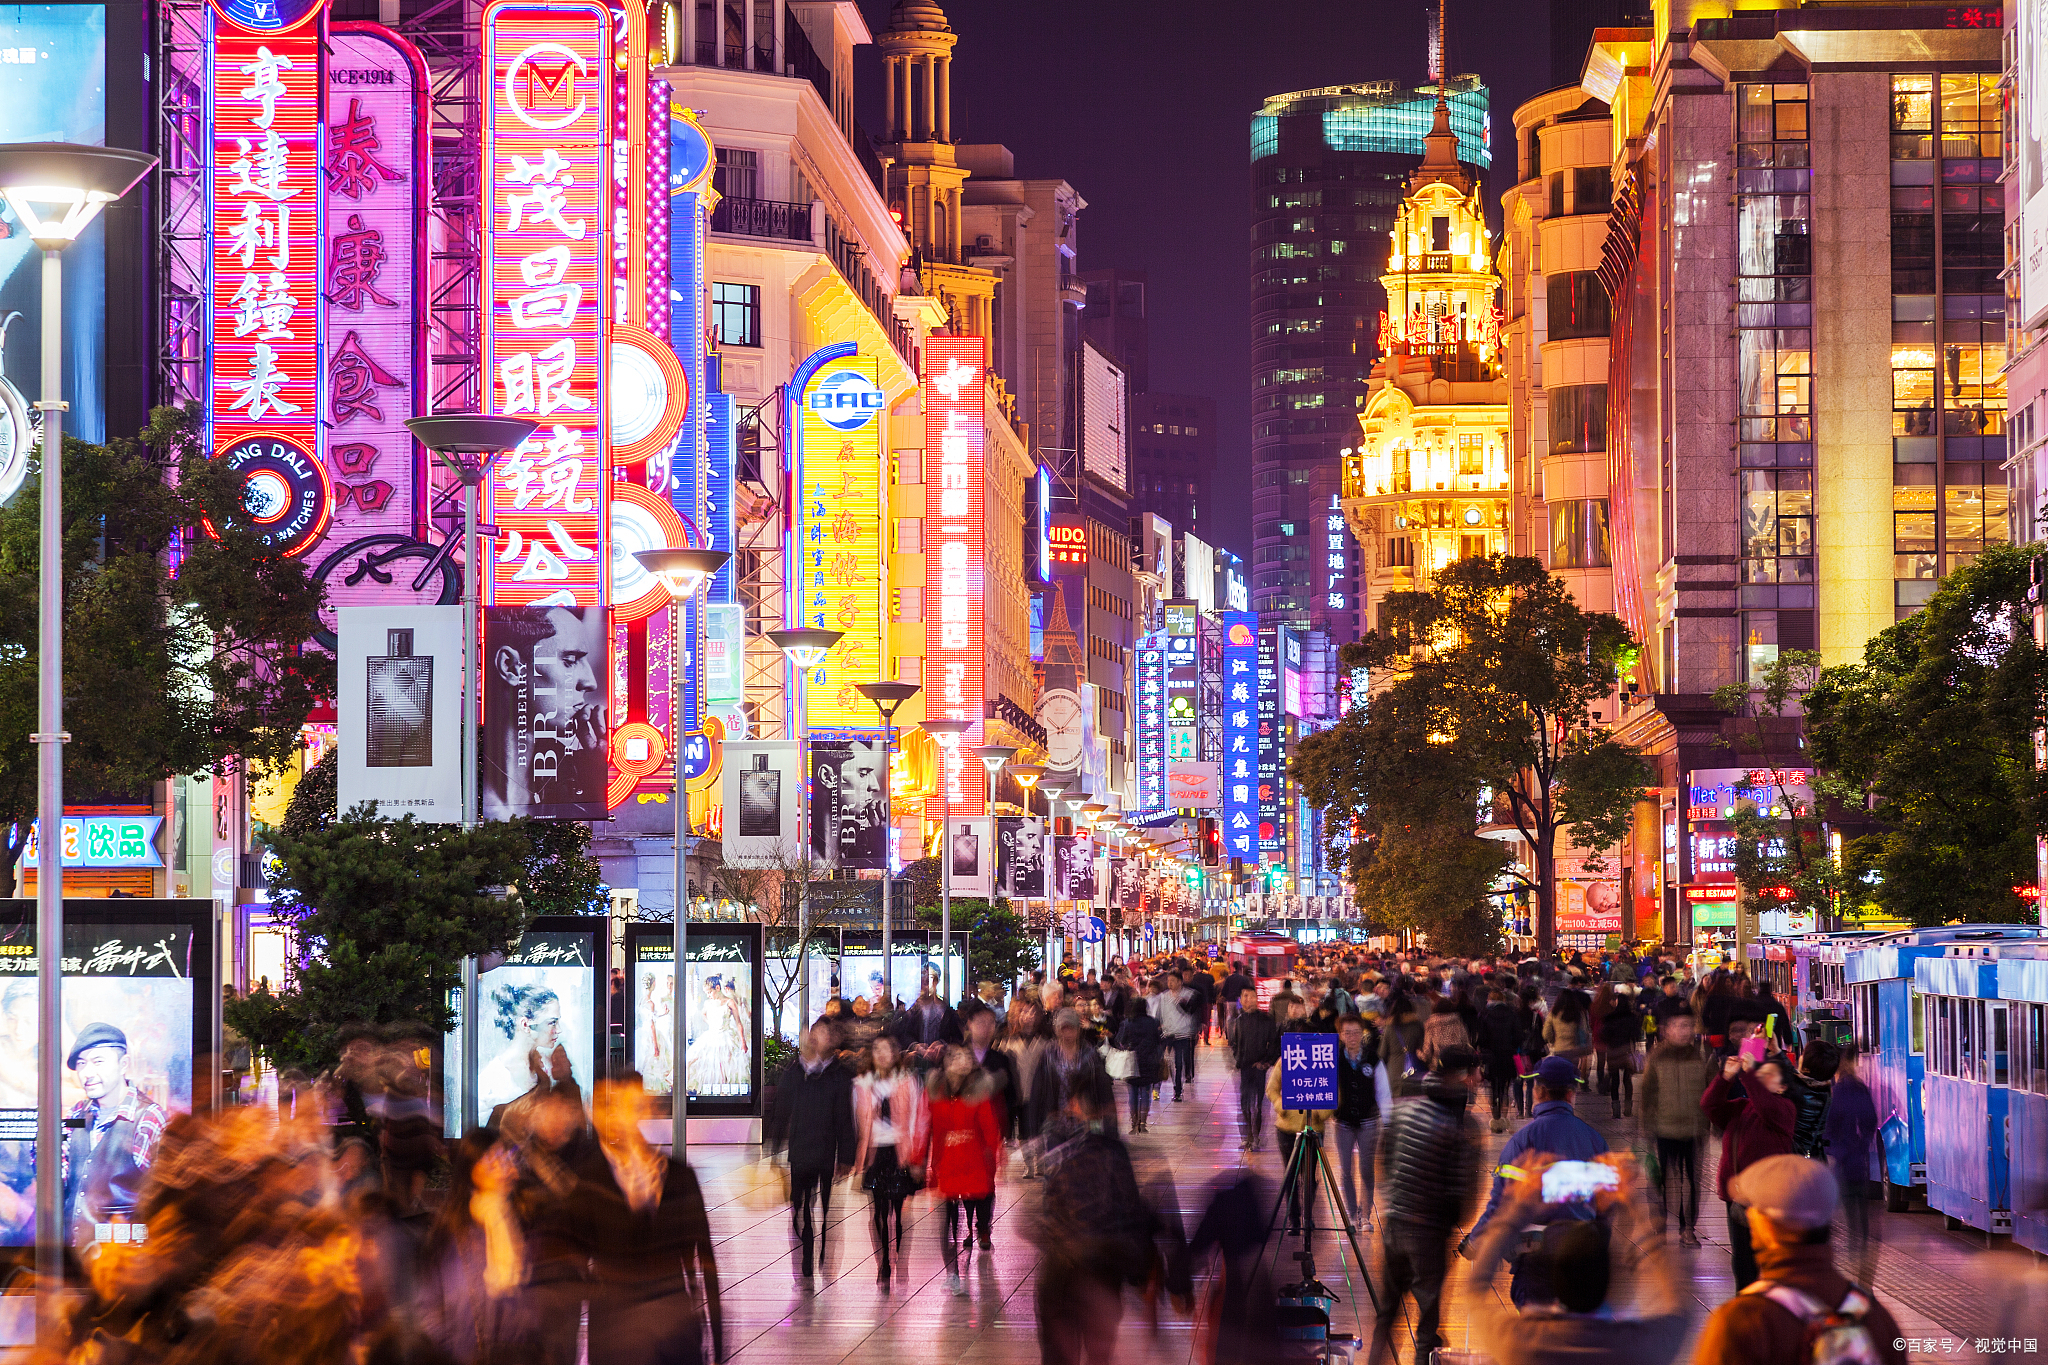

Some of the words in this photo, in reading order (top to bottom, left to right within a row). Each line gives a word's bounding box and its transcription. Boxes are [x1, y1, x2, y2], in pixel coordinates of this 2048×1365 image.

[329, 98, 407, 514] 泰康食品
[270, 443, 313, 480] DALI
[1327, 493, 1345, 609] 上海置地广场
[517, 662, 528, 768] BURBERRY
[533, 644, 558, 783] BRIT
[841, 762, 857, 846] BRIT
[1144, 807, 1179, 823] PHARMACY
[87, 823, 147, 859] 饮品
[1283, 1043, 1336, 1071] 快照
[1286, 1092, 1334, 1102] 一分钟成相
[1291, 1077, 1329, 1088] 10元/张
